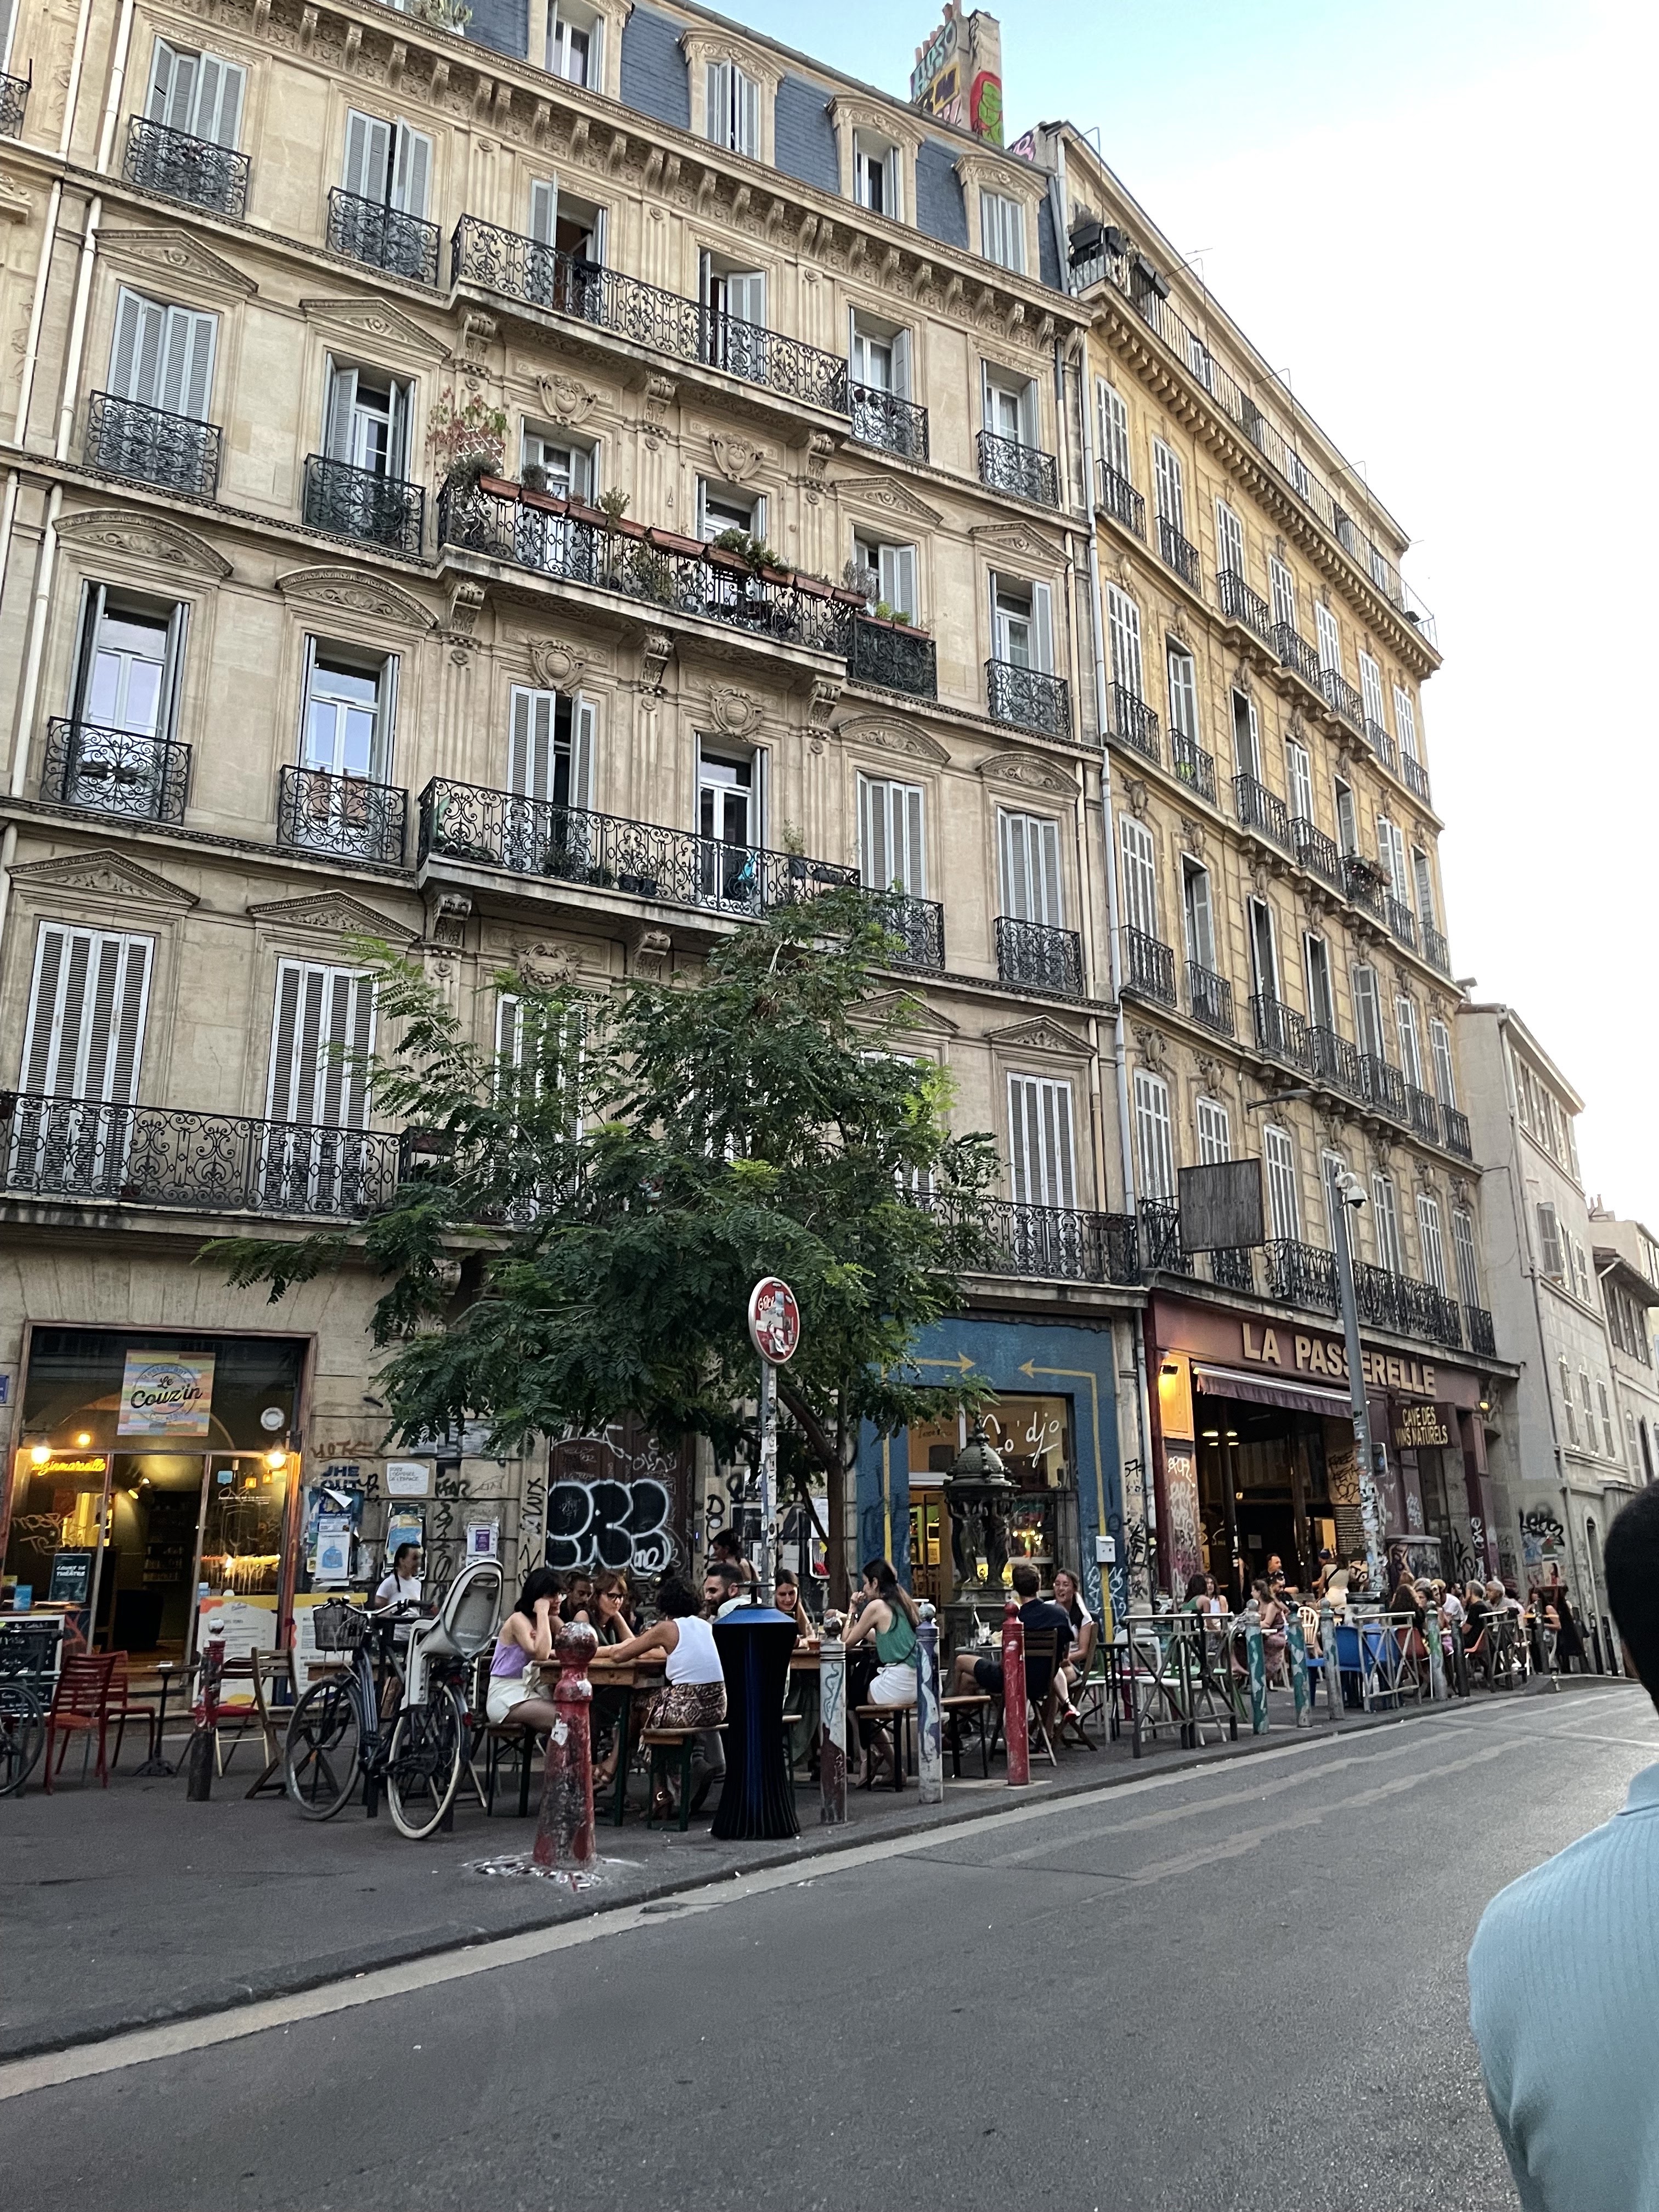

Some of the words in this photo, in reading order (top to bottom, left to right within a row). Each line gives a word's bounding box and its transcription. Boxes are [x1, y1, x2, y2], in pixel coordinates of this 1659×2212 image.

[1243, 1322, 1281, 1364] LA
[157, 1375, 173, 1389] Le
[131, 1383, 203, 1409] Couz'in
[1402, 1407, 1421, 1426] CAVE
[1421, 1406, 1436, 1425] DES
[1395, 1427, 1411, 1446] VINS
[1412, 1425, 1448, 1446] NATURELS
